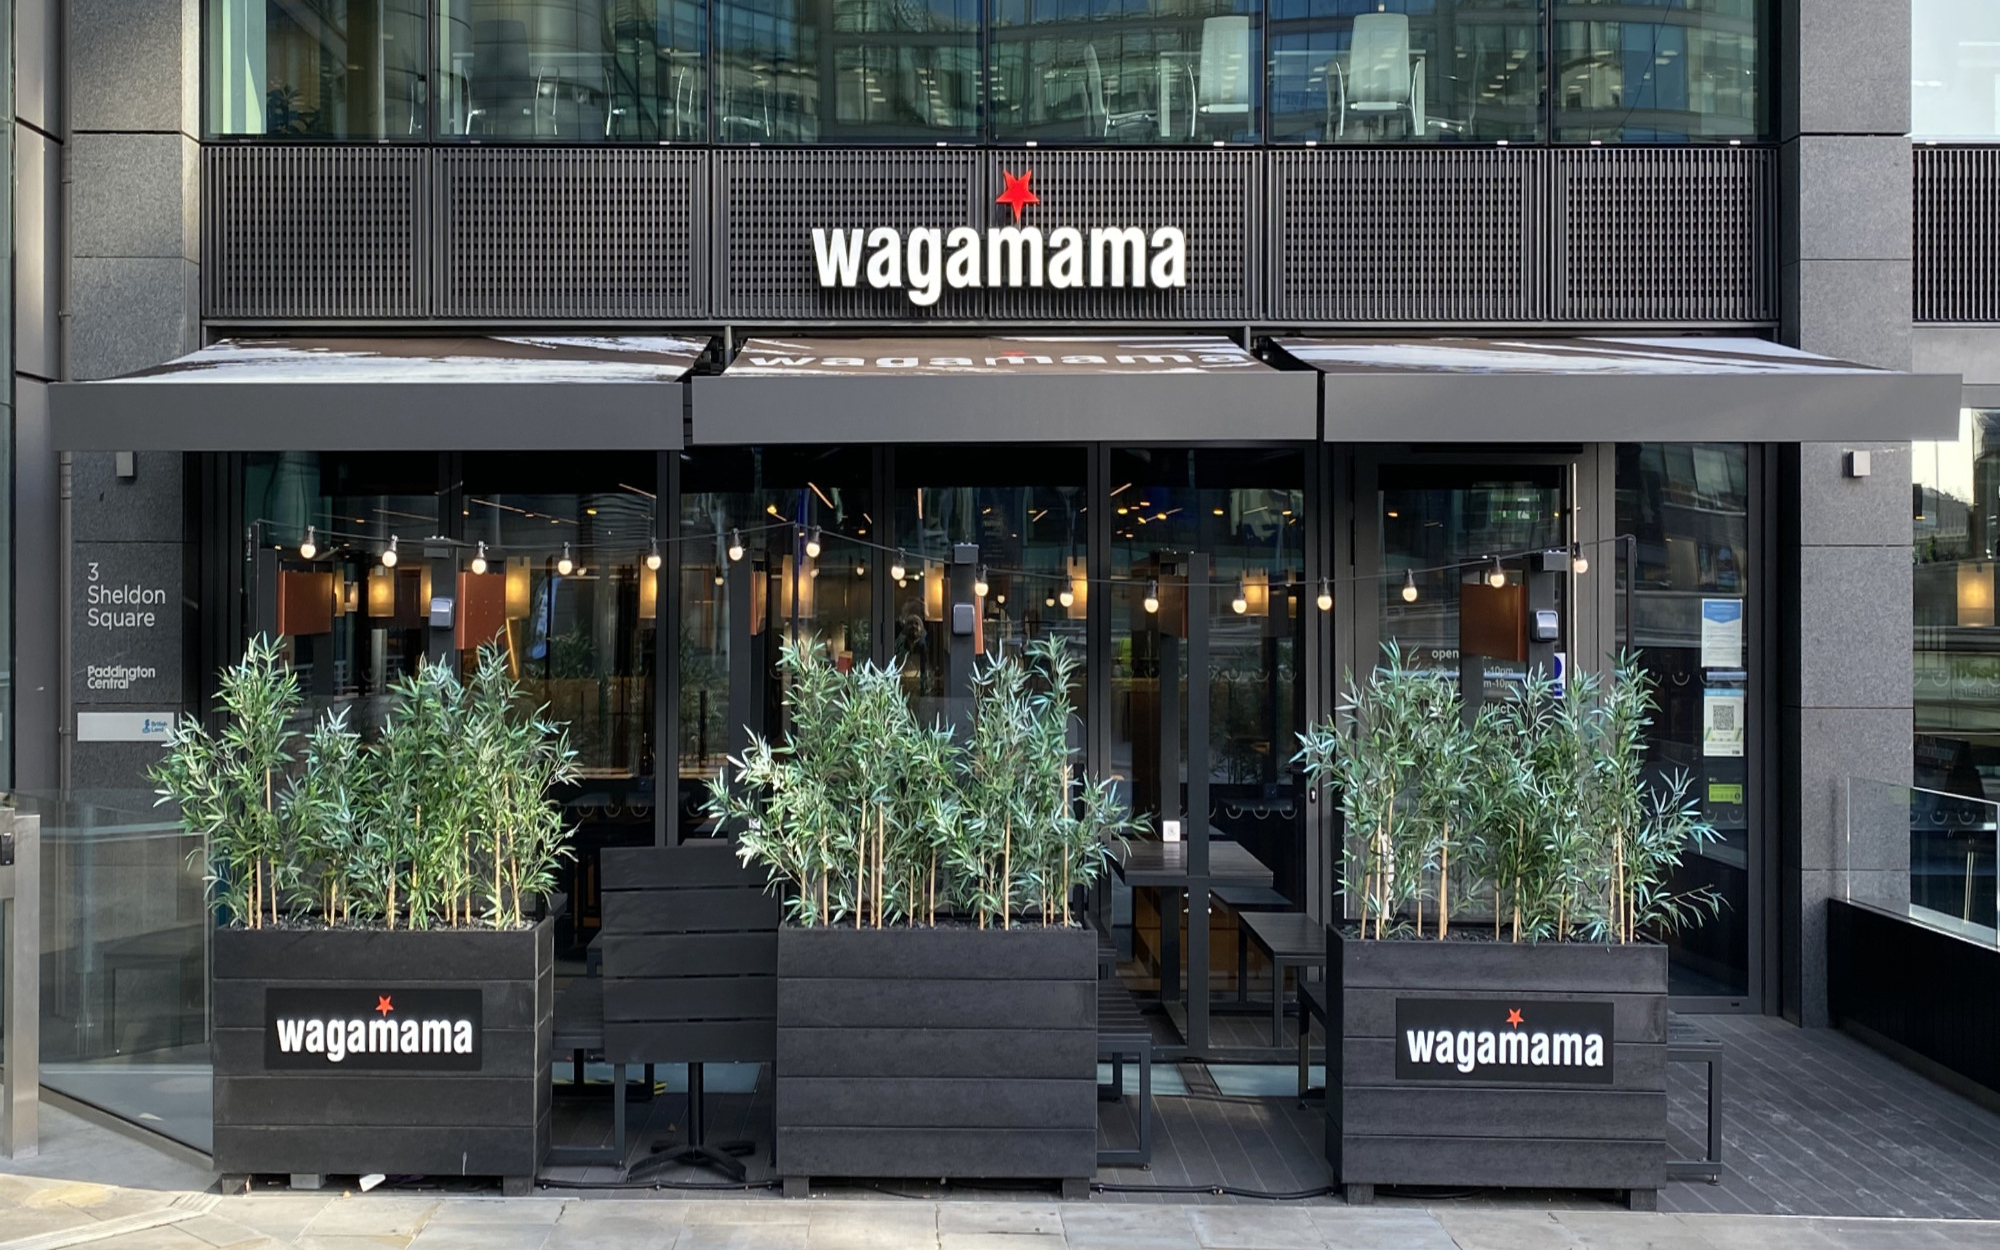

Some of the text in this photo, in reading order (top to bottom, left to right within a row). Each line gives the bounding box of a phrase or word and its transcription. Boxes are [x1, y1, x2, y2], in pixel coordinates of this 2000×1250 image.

[811, 226, 1186, 307] wagamama
[748, 353, 1248, 369] wagamama
[87, 562, 99, 582] 3
[87, 584, 166, 604] Sheldon
[87, 607, 155, 630] Square
[1432, 649, 1460, 661] open
[87, 665, 156, 681] Paddington
[87, 677, 129, 689] Central
[276, 1018, 473, 1062] wagamama
[1406, 1029, 1604, 1074] wagamama
